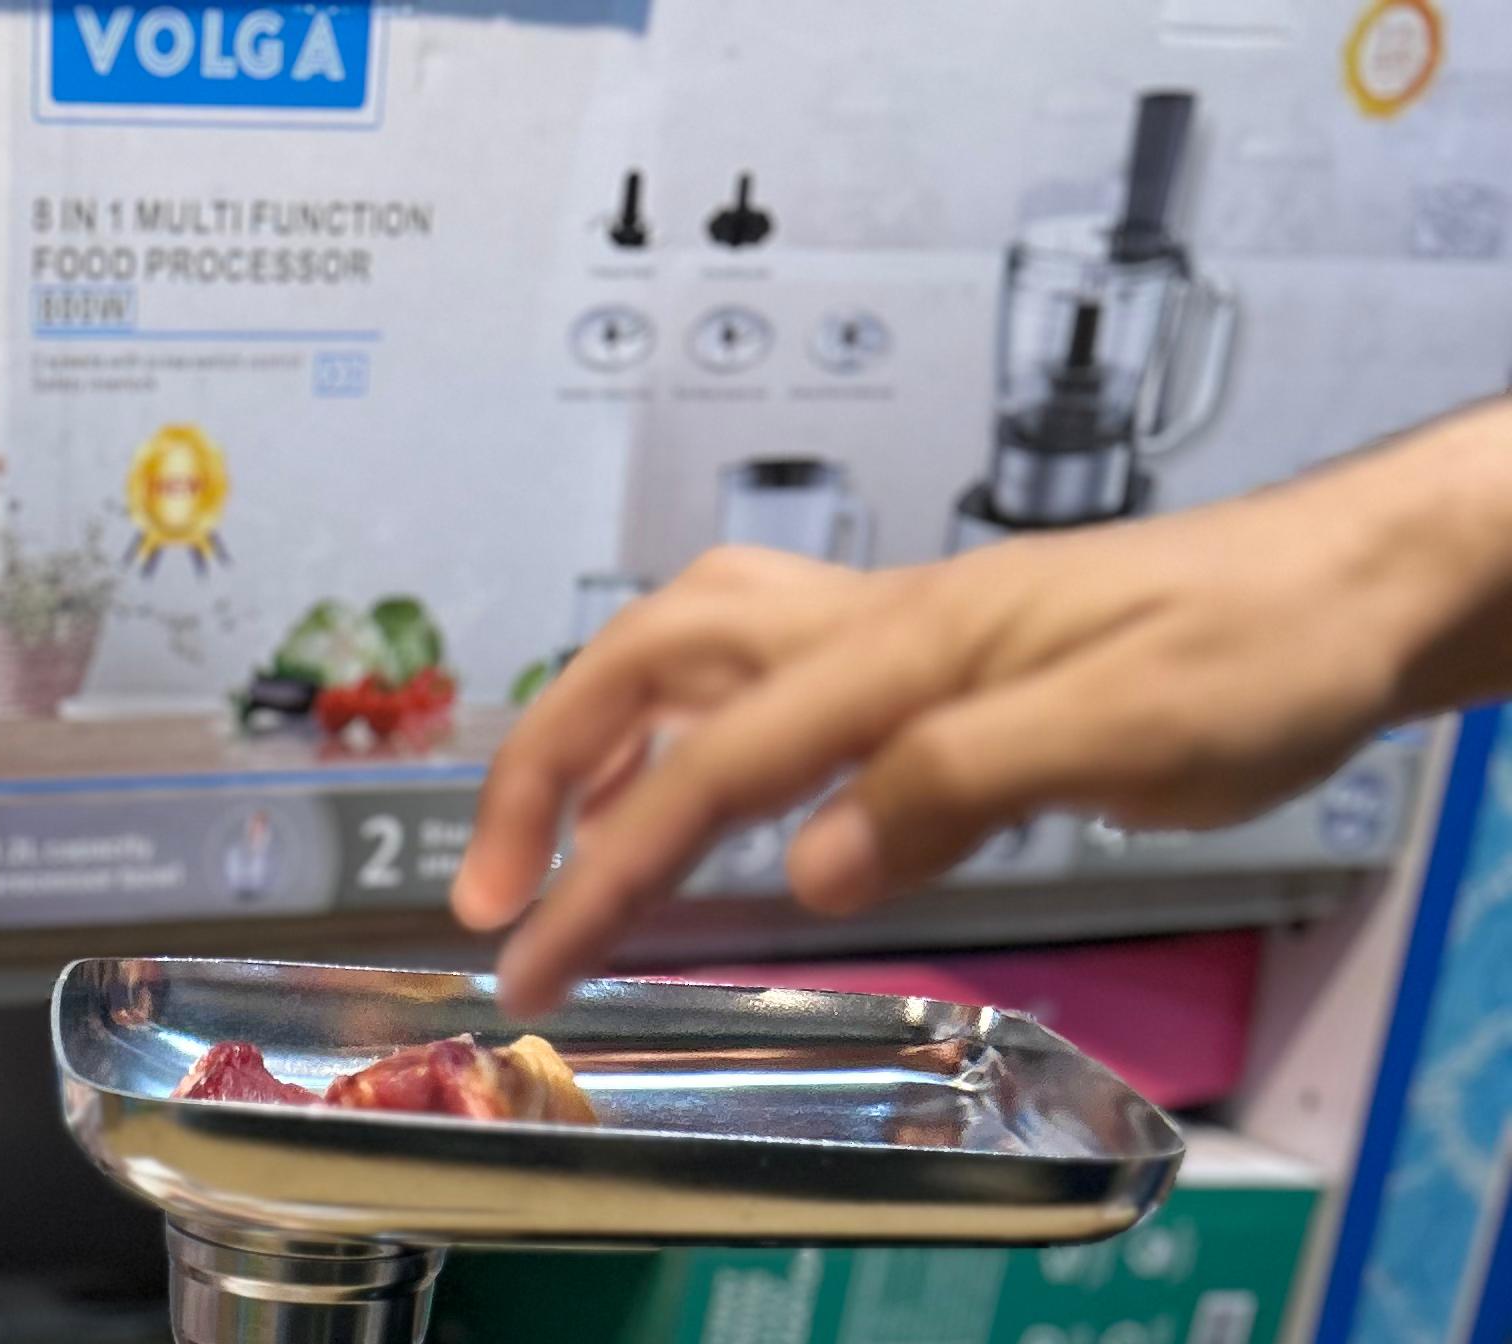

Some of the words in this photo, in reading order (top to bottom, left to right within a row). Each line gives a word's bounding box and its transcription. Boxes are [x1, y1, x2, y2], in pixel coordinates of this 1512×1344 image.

[73, 5, 347, 82] VOLGA
[60, 198, 97, 233] IN
[134, 198, 245, 236] MULTI
[248, 200, 434, 238] FUNCTION
[31, 246, 137, 281] FOOD
[144, 247, 374, 284] PROCESSOR
[358, 814, 403, 888] 2
